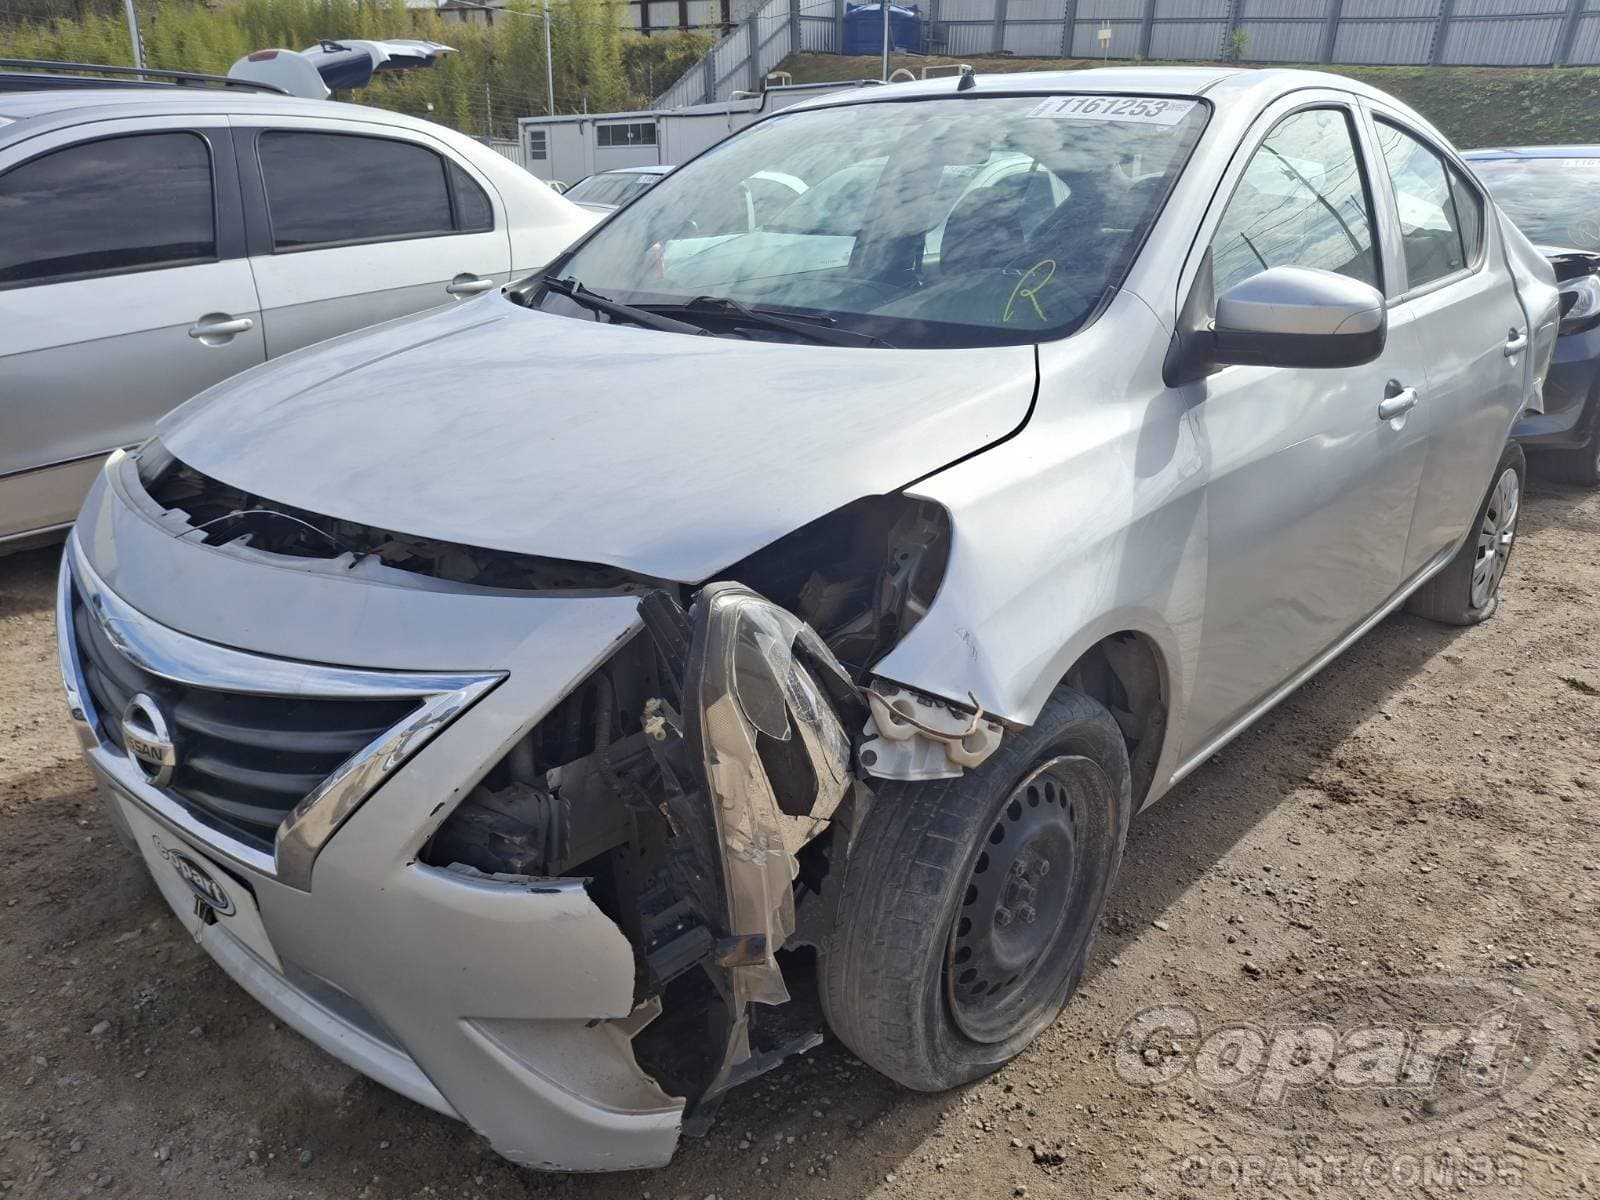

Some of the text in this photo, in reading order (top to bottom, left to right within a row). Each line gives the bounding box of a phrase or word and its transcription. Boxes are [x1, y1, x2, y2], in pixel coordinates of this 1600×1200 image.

[1055, 97, 1169, 117] 1161253
[1003, 259, 1056, 322] R
[152, 834, 225, 906] Copart
